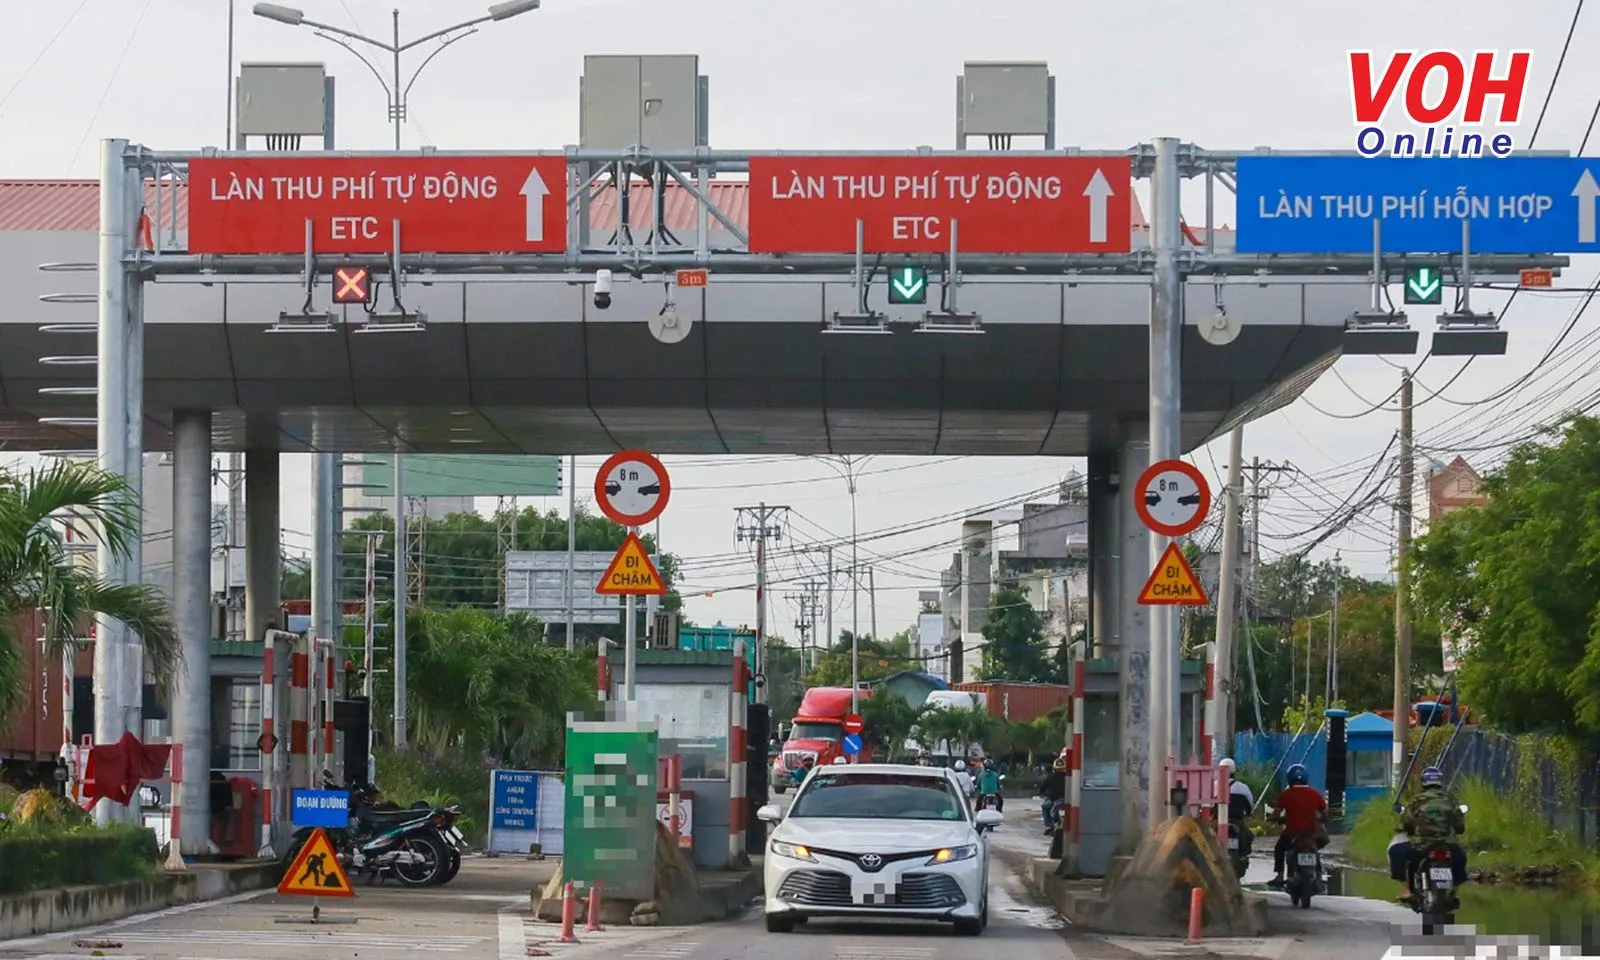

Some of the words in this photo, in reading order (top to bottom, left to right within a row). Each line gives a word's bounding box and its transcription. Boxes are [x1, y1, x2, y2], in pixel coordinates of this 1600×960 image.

[210, 172, 263, 200] LÀN
[271, 177, 322, 199] THU
[331, 171, 376, 199] PHÍ
[381, 173, 417, 203] TỰ
[423, 171, 497, 203] ĐỘNG
[771, 170, 825, 199] LÀN
[832, 176, 885, 199] THU
[894, 170, 938, 199] PHÍ
[944, 174, 979, 203] TỰ
[986, 172, 1062, 203] ĐỘNG
[1258, 189, 1312, 219] LÀN
[1320, 195, 1373, 218] THU
[1382, 189, 1427, 219] PHÍ
[1434, 185, 1489, 219] HỖN
[1498, 194, 1553, 224] HỢP
[331, 217, 378, 240] ETC
[892, 217, 940, 239] ETC
[682, 273, 702, 285] 5m
[1525, 273, 1546, 284] 5m
[620, 468, 626, 481] 8
[629, 472, 639, 481] m
[1159, 479, 1166, 491] 8
[1169, 482, 1178, 491] m
[625, 556, 639, 568] ĐI
[1166, 566, 1180, 578] ĐI
[296, 797, 319, 810] ĐOẠN
[320, 796, 348, 809] ĐƯỜNG
